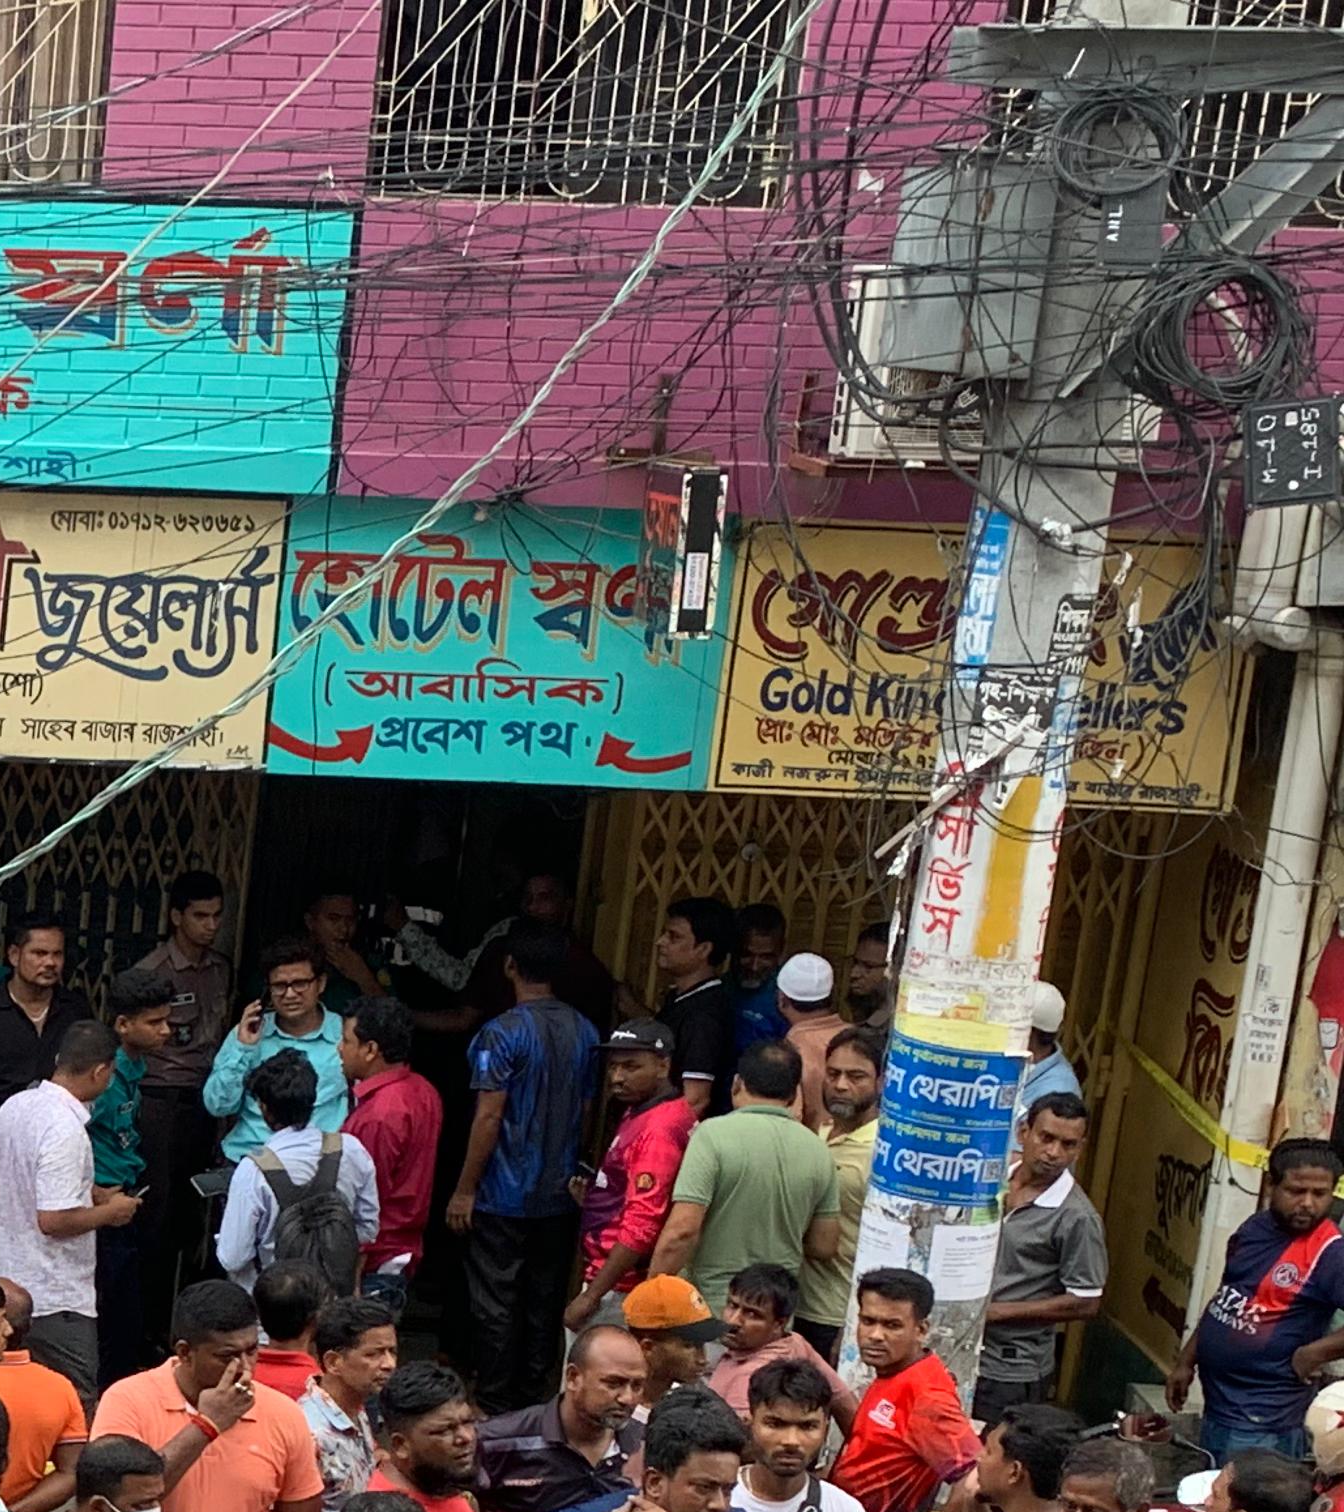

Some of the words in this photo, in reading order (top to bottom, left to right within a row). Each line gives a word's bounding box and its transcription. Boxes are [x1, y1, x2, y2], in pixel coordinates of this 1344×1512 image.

[291, 534, 508, 656] হোটেল
[760, 667, 855, 716] Gold
[21, 717, 76, 741] সাহেব
[82, 720, 137, 744] বাজার
[375, 715, 486, 755] প্রবেশ
[731, 758, 774, 778] কাজী
[909, 1074, 1000, 1110] থেরাপি
[893, 1147, 984, 1183] থেরাপি
